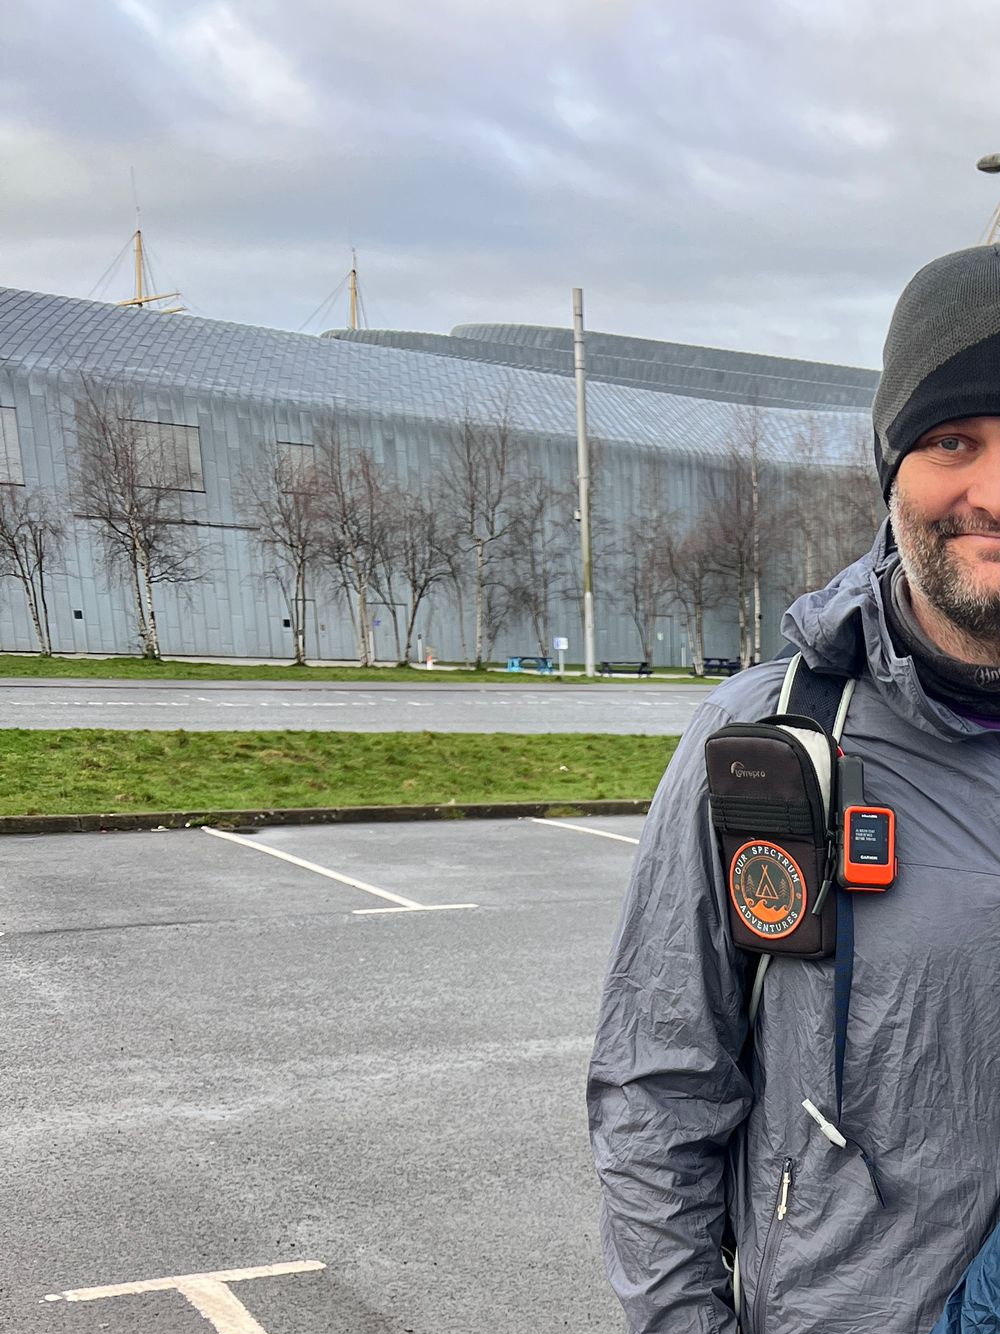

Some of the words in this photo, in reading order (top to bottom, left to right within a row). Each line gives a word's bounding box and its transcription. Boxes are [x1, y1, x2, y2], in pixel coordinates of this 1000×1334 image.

[735, 854, 748, 875] OUR
[751, 846, 800, 883] SPECTRUM
[740, 904, 798, 932] ADVENTURES
